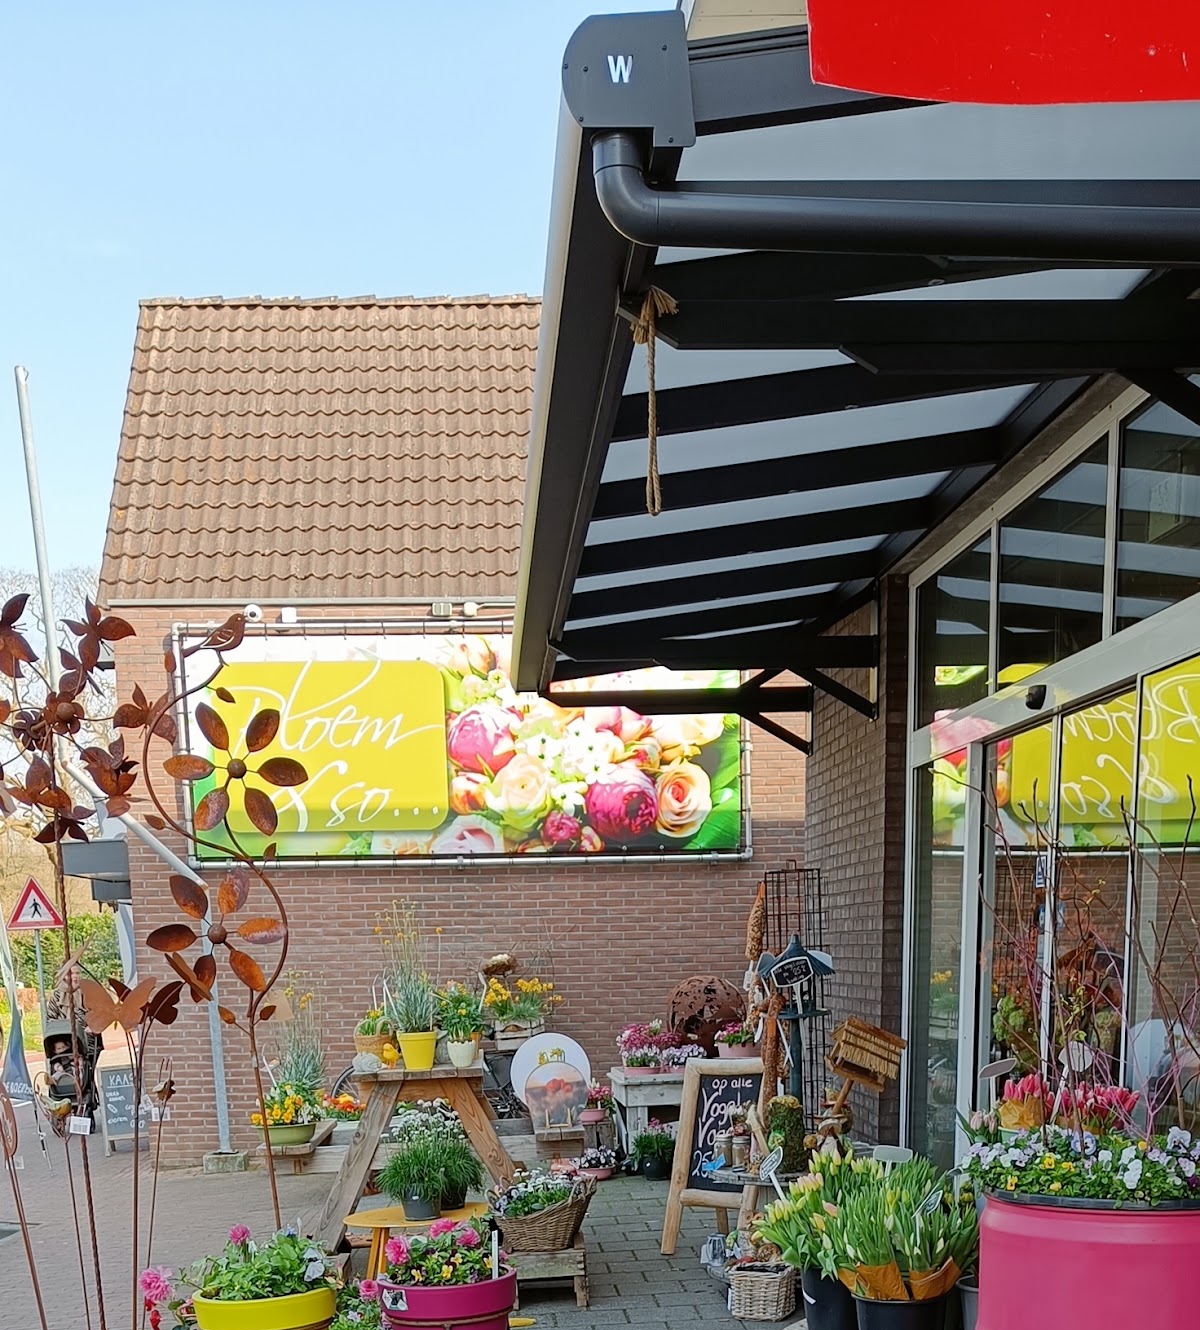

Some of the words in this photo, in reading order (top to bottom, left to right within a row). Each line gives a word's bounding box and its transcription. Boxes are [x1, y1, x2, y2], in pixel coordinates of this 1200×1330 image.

[607, 55, 633, 83] W
[712, 1078, 728, 1096] op
[731, 1077, 753, 1089] alle
